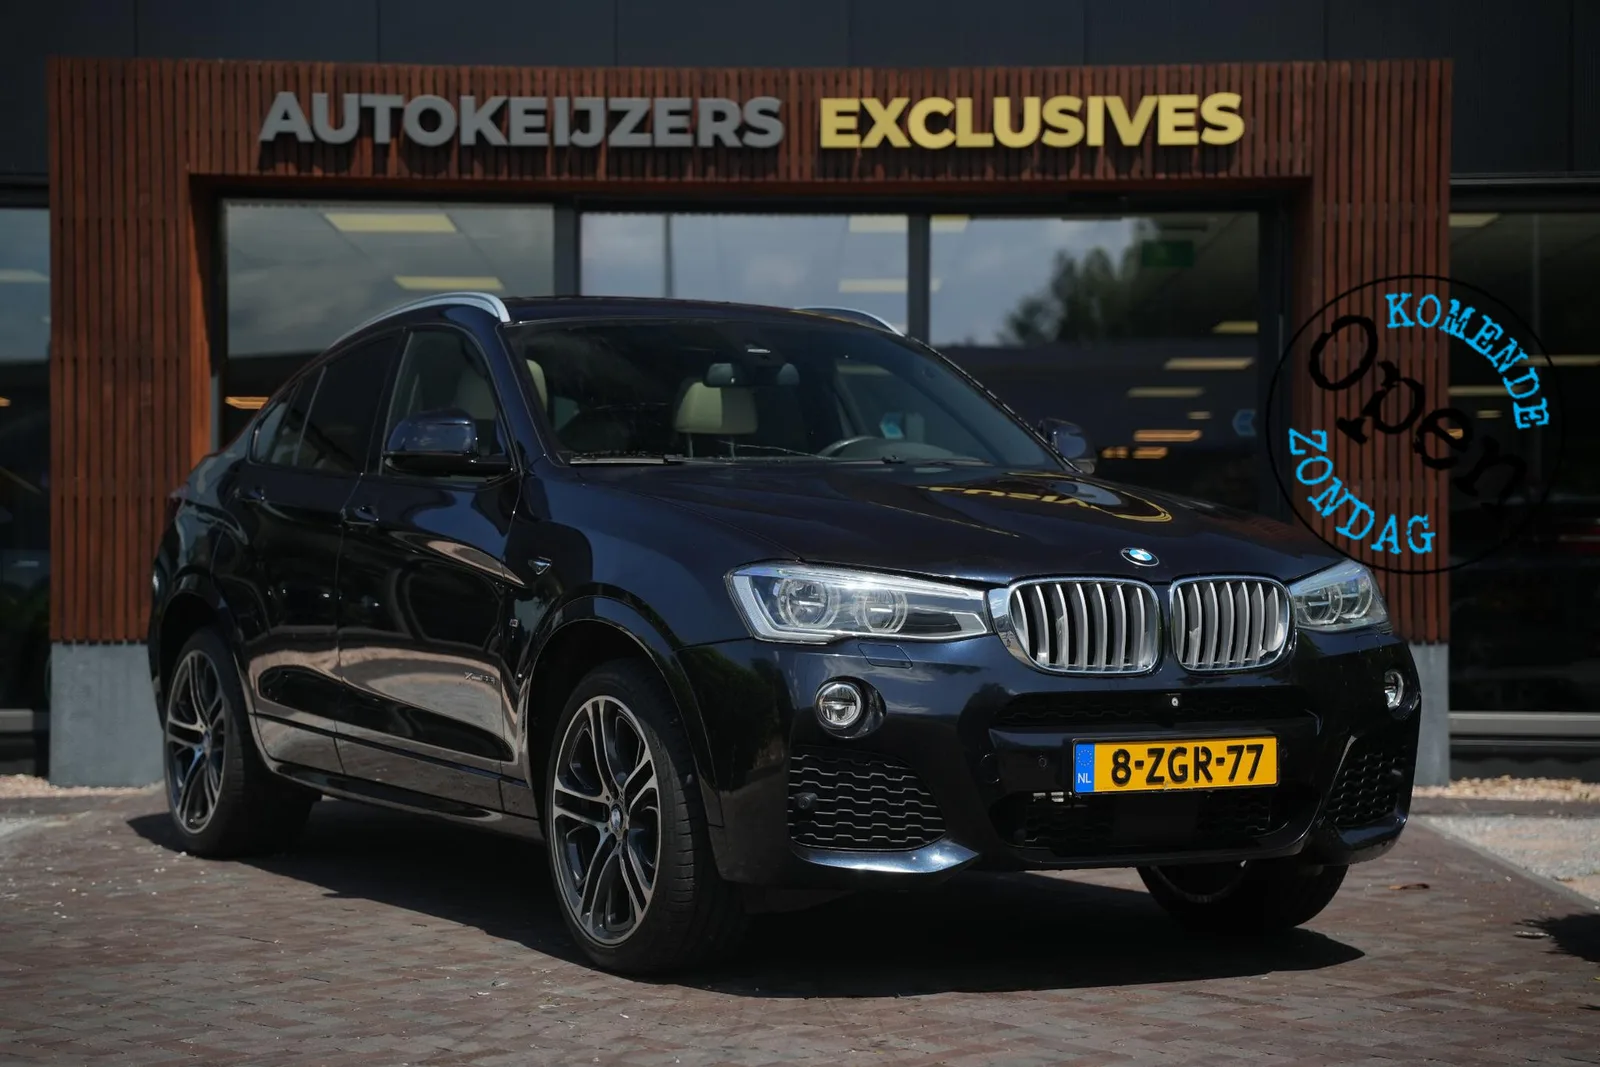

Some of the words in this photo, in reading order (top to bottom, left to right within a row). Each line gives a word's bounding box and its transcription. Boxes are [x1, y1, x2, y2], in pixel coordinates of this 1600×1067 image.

[259, 91, 785, 149] AUTOKEIJZERS
[820, 91, 1245, 149] EXCLUSIVES
[1077, 772, 1092, 784] NL
[1112, 744, 1264, 786] 8-ZGR-77
